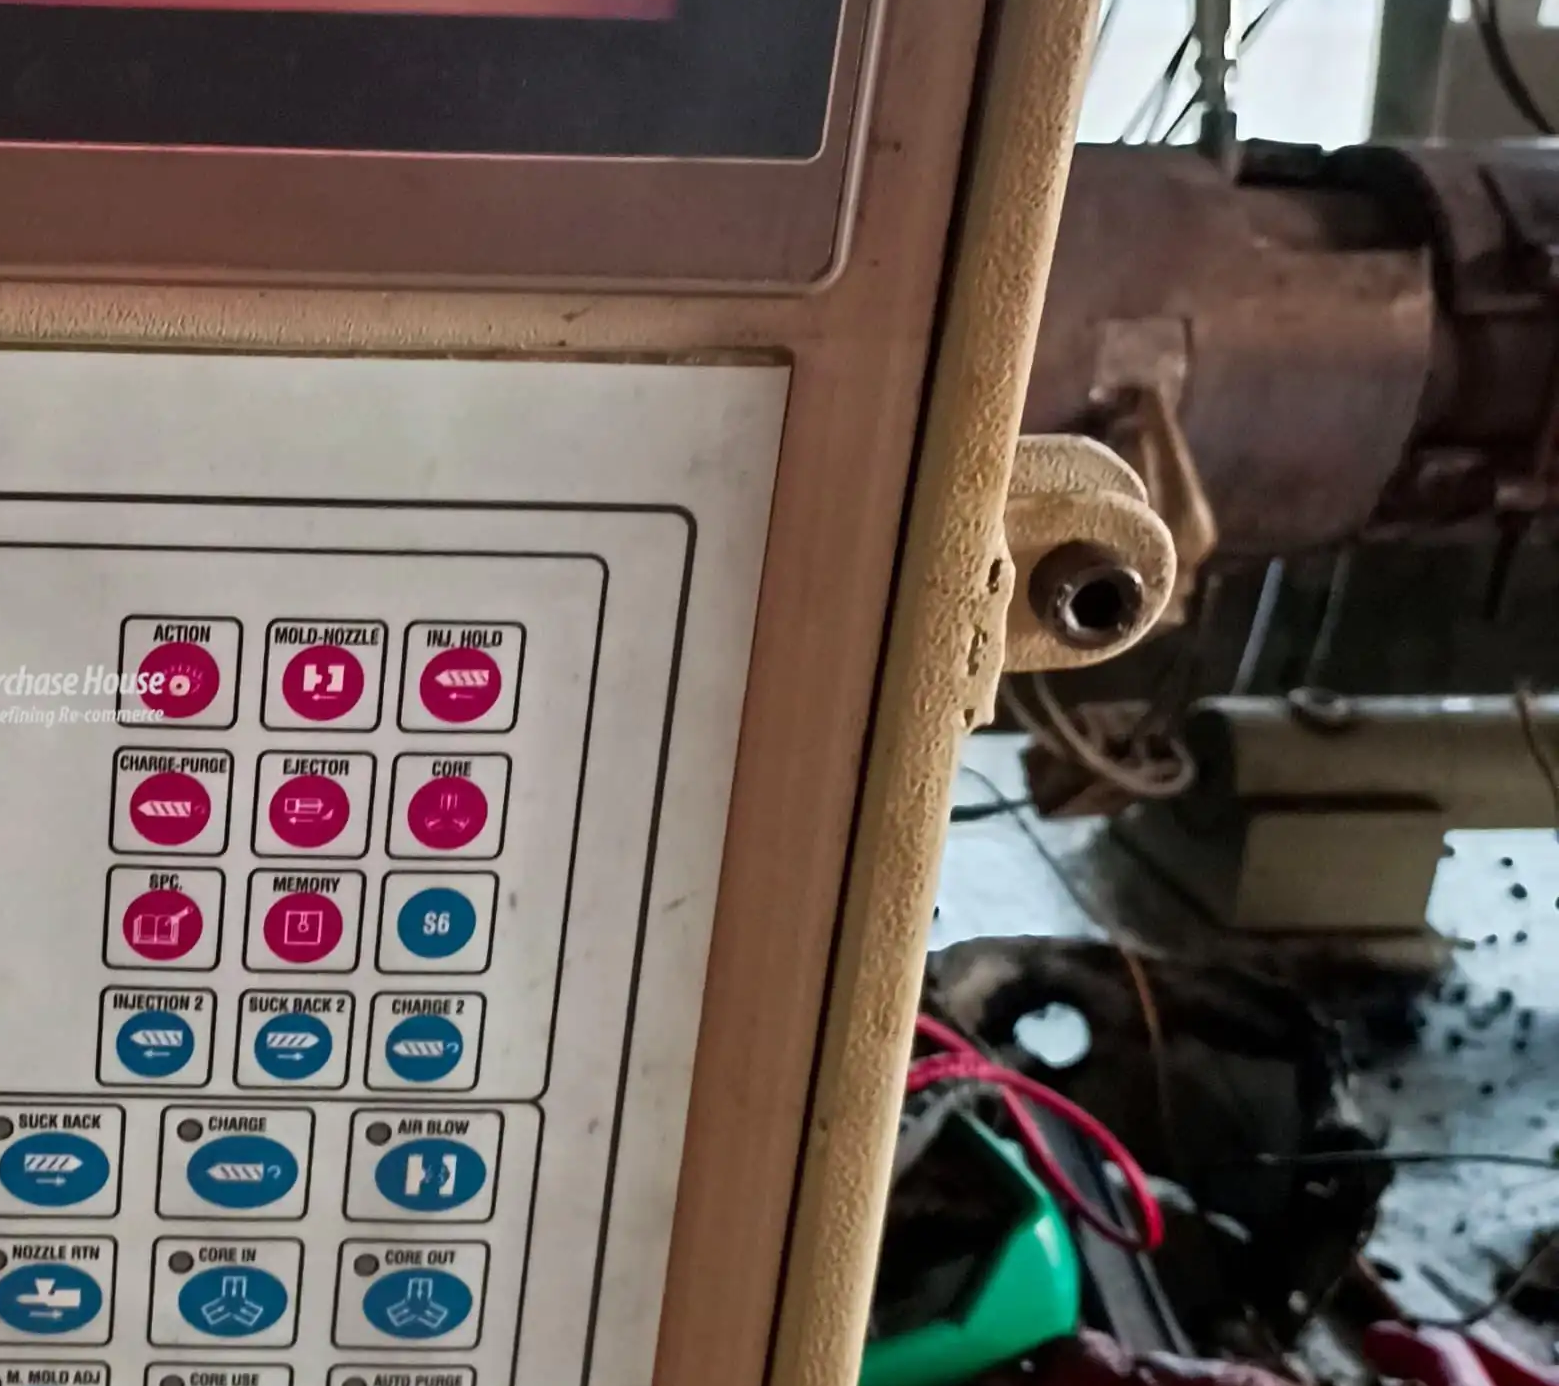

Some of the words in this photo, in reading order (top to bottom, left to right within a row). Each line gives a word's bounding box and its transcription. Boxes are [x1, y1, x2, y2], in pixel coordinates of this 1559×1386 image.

[153, 624, 211, 644] ACTION
[274, 626, 380, 647] MOLD-NOZZLE
[459, 629, 503, 650] HOLD
[119, 754, 227, 775] CHARGE-PURGE
[282, 758, 350, 777] EJECTOR
[431, 760, 472, 778] CORE
[272, 876, 341, 894] MEMORY
[423, 912, 450, 934] S6
[113, 993, 190, 1012] INJECTION
[194, 995, 204, 1011] 2
[249, 996, 289, 1014] SUCK
[292, 997, 332, 1015] BACK
[336, 998, 346, 1013] 2
[391, 998, 451, 1016] CHARGE
[455, 999, 465, 1015] 2
[18, 1113, 58, 1129] SUCK
[62, 1114, 101, 1130] BACK
[208, 1116, 267, 1132] CHARGE
[397, 1119, 423, 1135] AIR
[426, 1119, 470, 1136] BLOW
[12, 1245, 66, 1261] NOZZLE
[71, 1245, 100, 1261] RTN
[198, 1247, 237, 1263] CORE
[241, 1248, 257, 1262] IN
[384, 1249, 422, 1265] CORE
[427, 1250, 456, 1266] OUT
[28, 1370, 68, 1385] MOLD
[72, 1370, 101, 1385] ADJ
